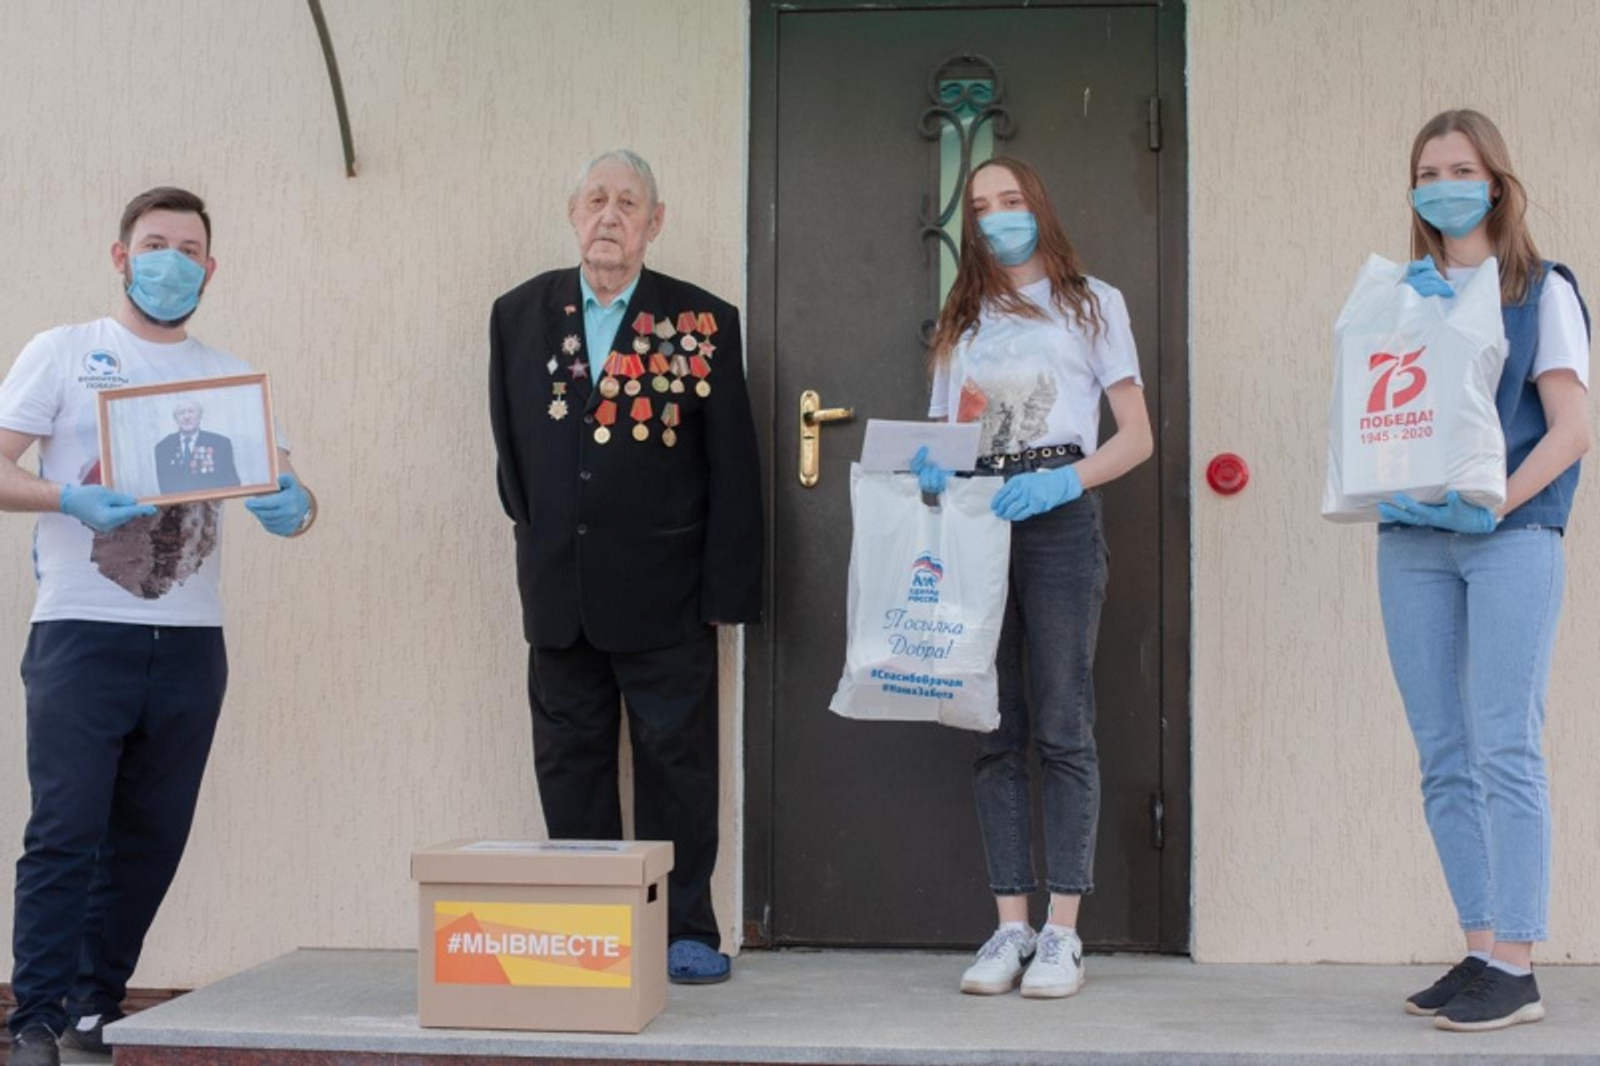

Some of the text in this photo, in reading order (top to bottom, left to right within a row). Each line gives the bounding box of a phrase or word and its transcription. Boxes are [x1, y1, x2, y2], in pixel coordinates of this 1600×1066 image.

[1366, 345, 1427, 413] 75
[1360, 410, 1434, 429] ПОБЕДА!
[1361, 430, 1390, 443] 1945
[1402, 426, 1433, 439] 2020
[883, 608, 963, 635] Посылка
[888, 633, 954, 661] Добра!
[447, 932, 620, 957] #МЫВМЕСТЕ
